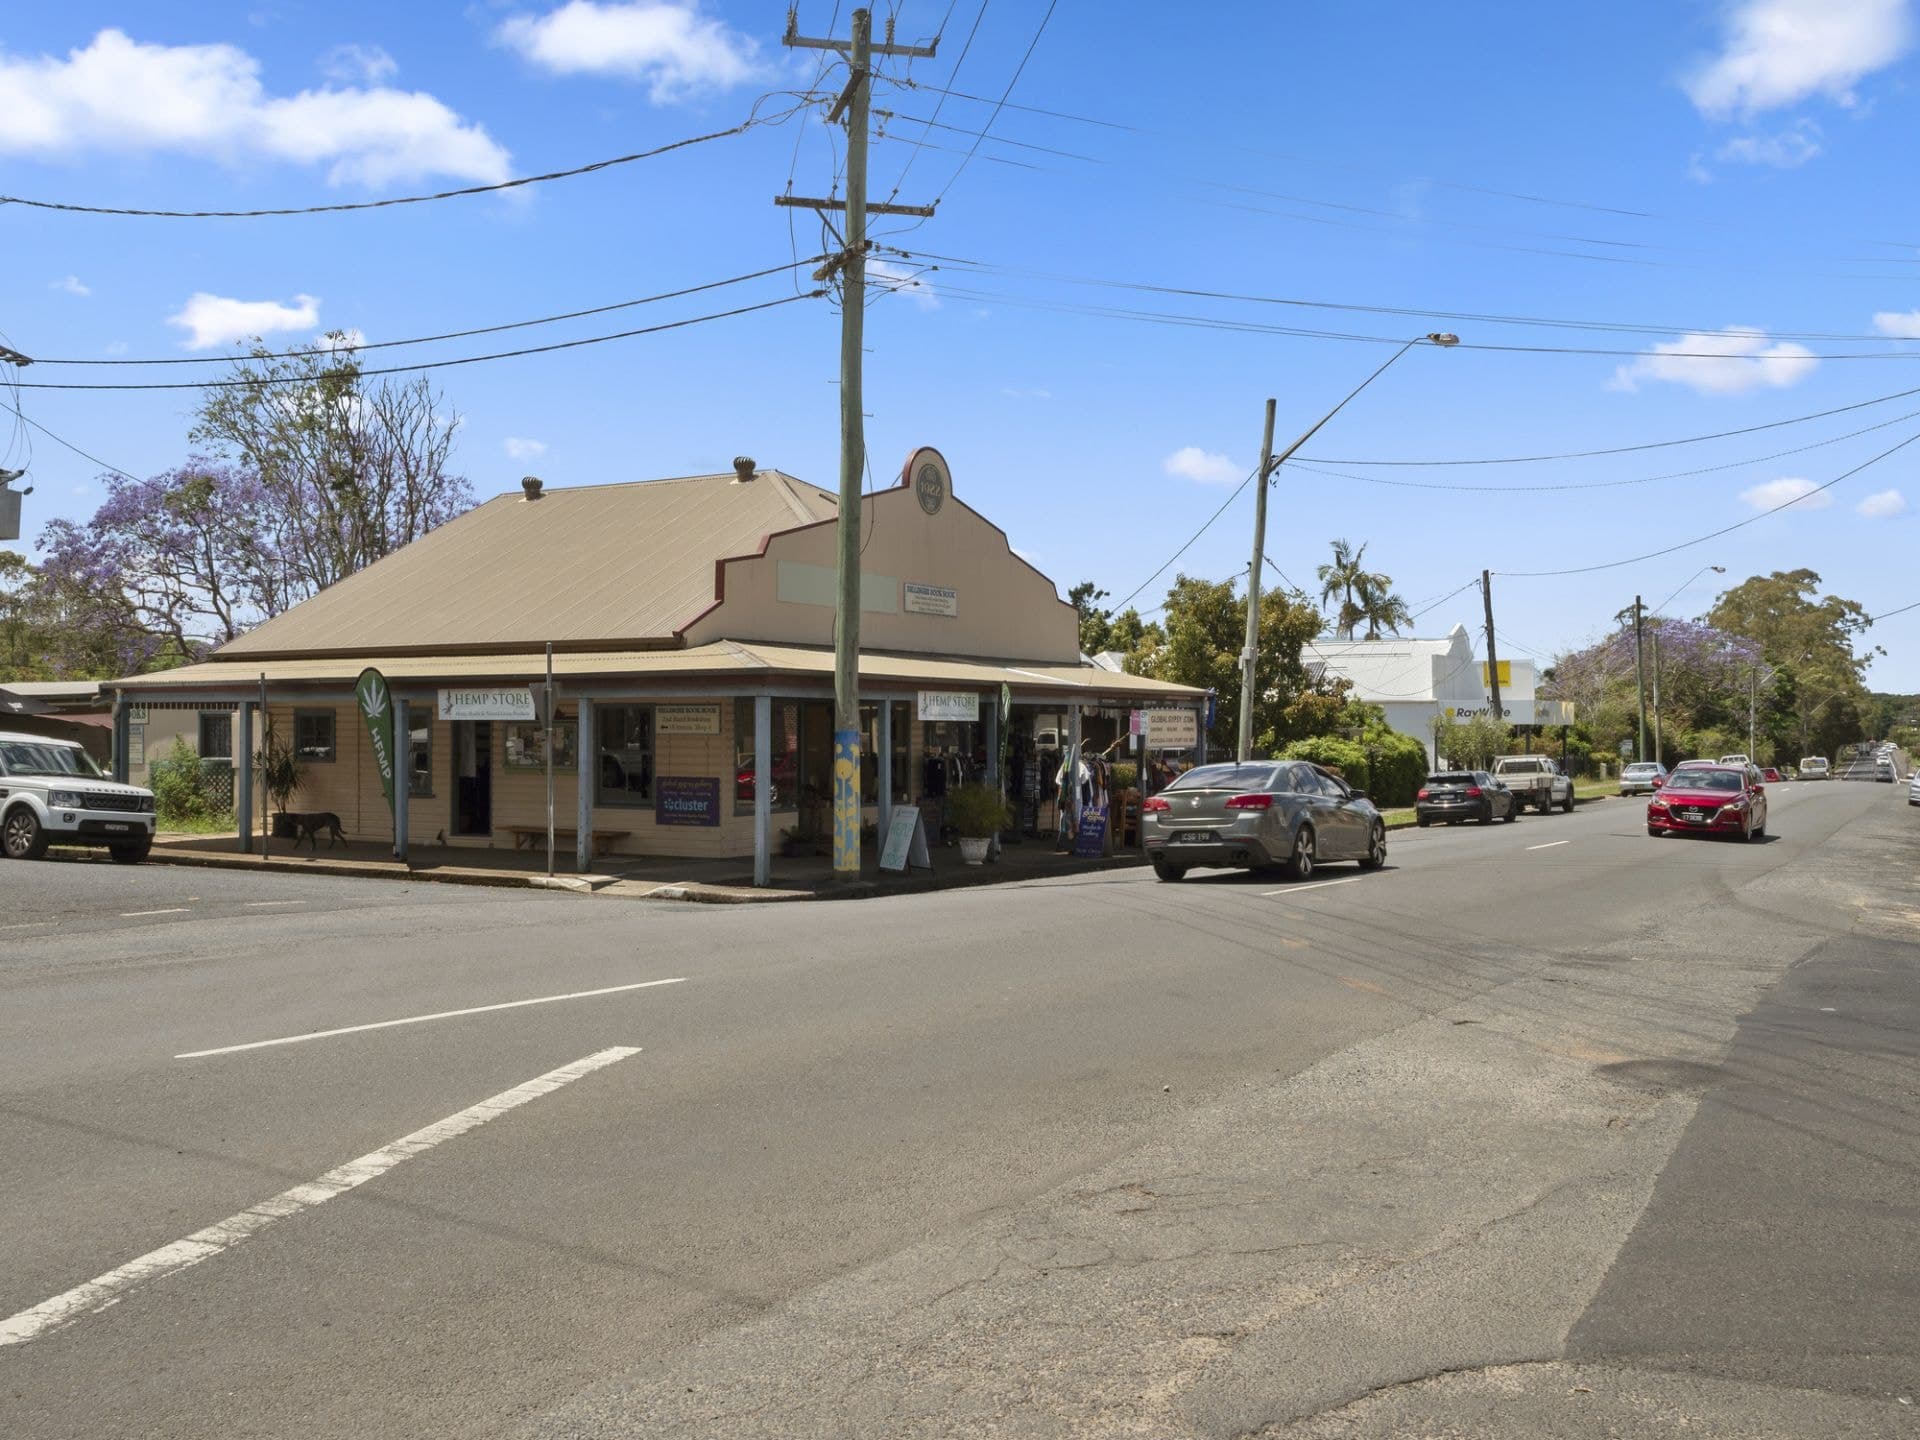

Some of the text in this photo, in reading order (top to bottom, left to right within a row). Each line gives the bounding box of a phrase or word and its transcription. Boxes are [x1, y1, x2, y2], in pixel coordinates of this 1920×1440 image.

[455, 693, 530, 706] HEMP STORE
[929, 695, 976, 708] HEMP STORE
[371, 727, 391, 779] HEMP
[674, 798, 708, 811] cluster
